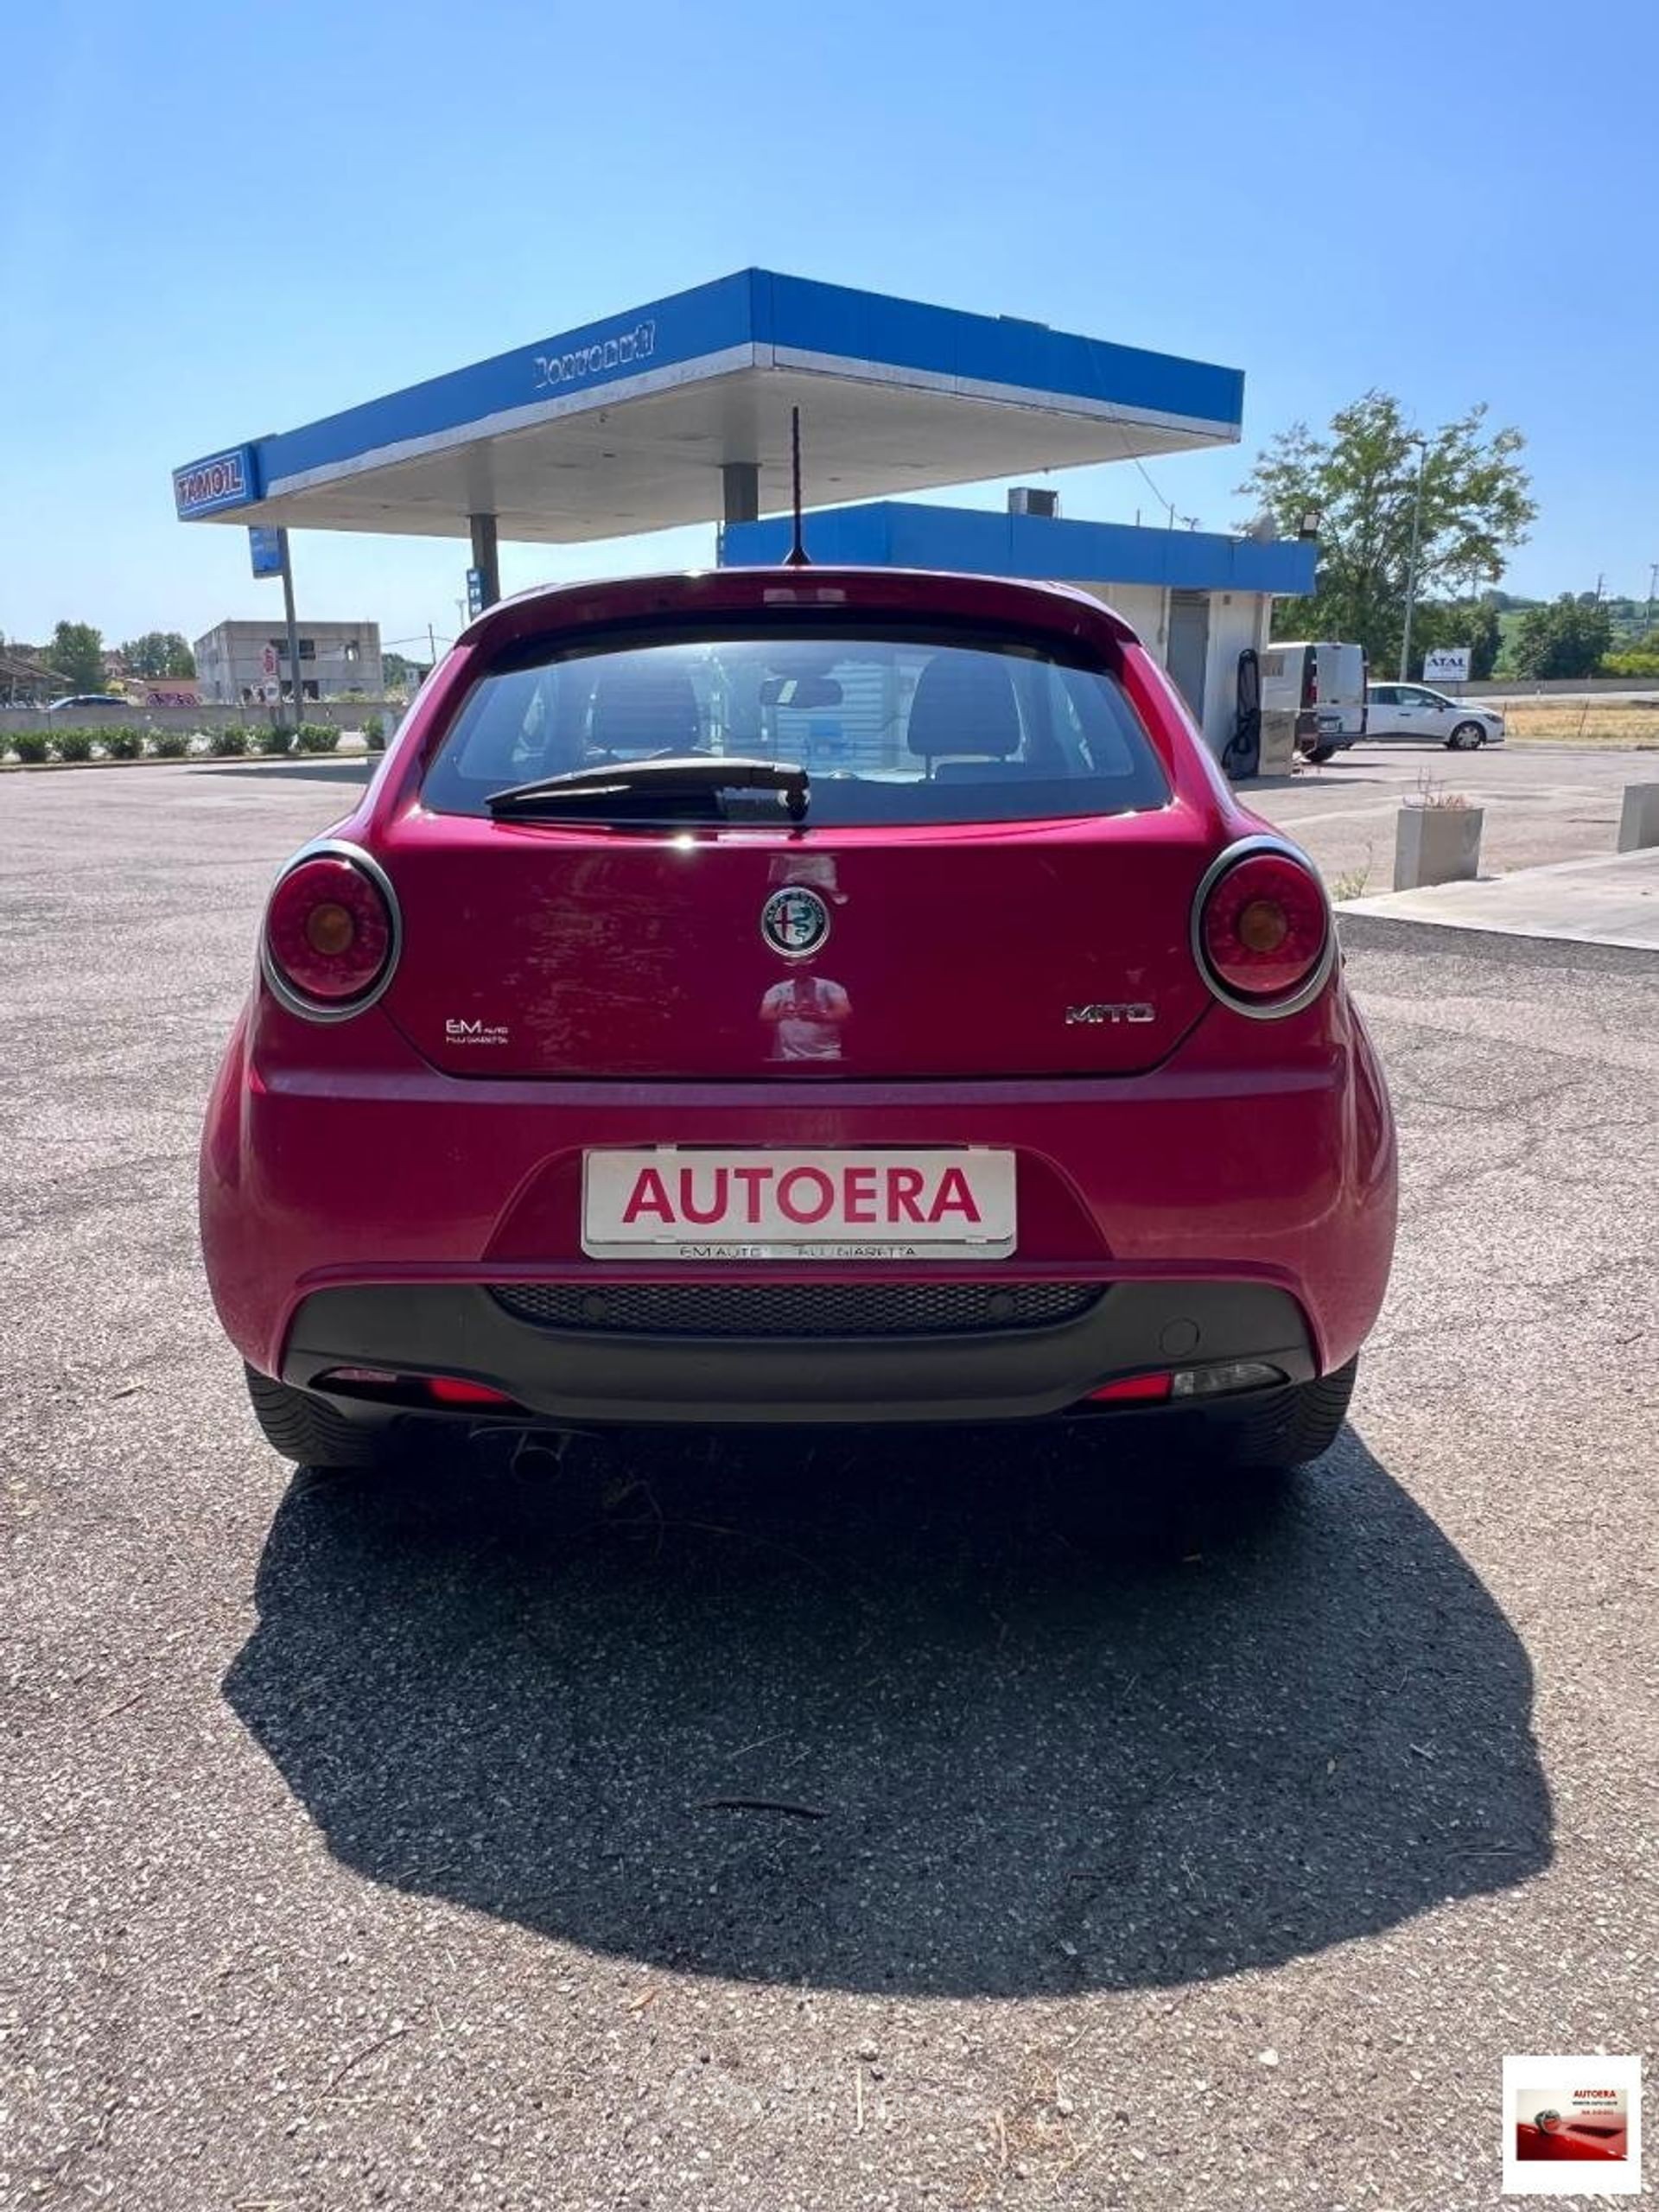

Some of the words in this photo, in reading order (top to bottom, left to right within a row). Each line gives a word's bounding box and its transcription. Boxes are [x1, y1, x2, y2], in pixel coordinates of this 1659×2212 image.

[176, 461, 243, 506] TAMOIL
[1065, 1003, 1154, 1024] MITO
[445, 1019, 481, 1033] EM
[622, 1166, 982, 1224] AUTOERA
[680, 1246, 711, 1256] EM
